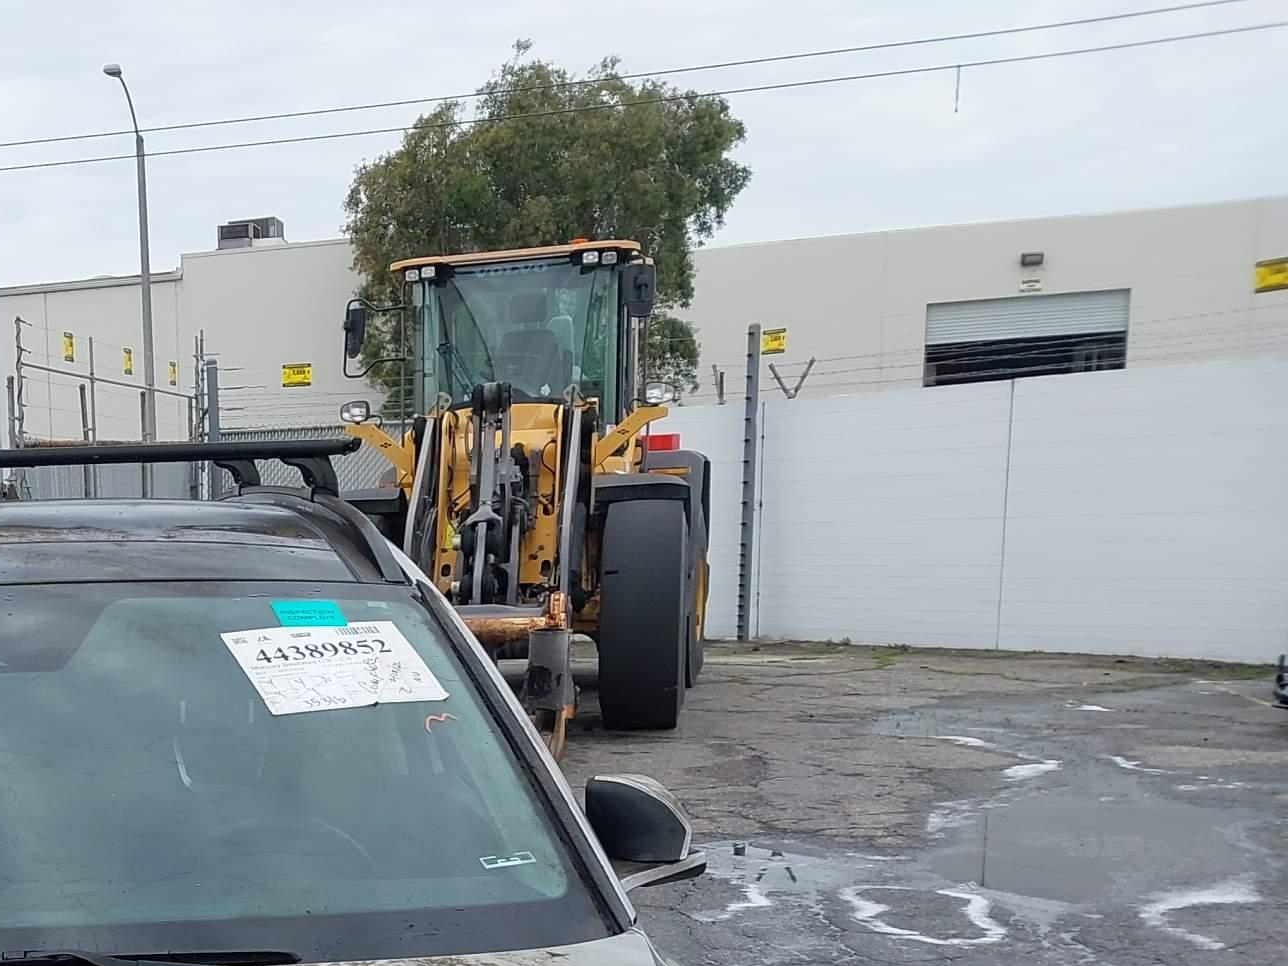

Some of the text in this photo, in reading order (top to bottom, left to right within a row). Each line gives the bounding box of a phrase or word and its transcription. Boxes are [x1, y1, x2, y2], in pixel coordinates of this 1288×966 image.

[476, 261, 548, 278] VOLVO
[279, 608, 335, 616] INSPECTION
[256, 639, 393, 663] 44389852
